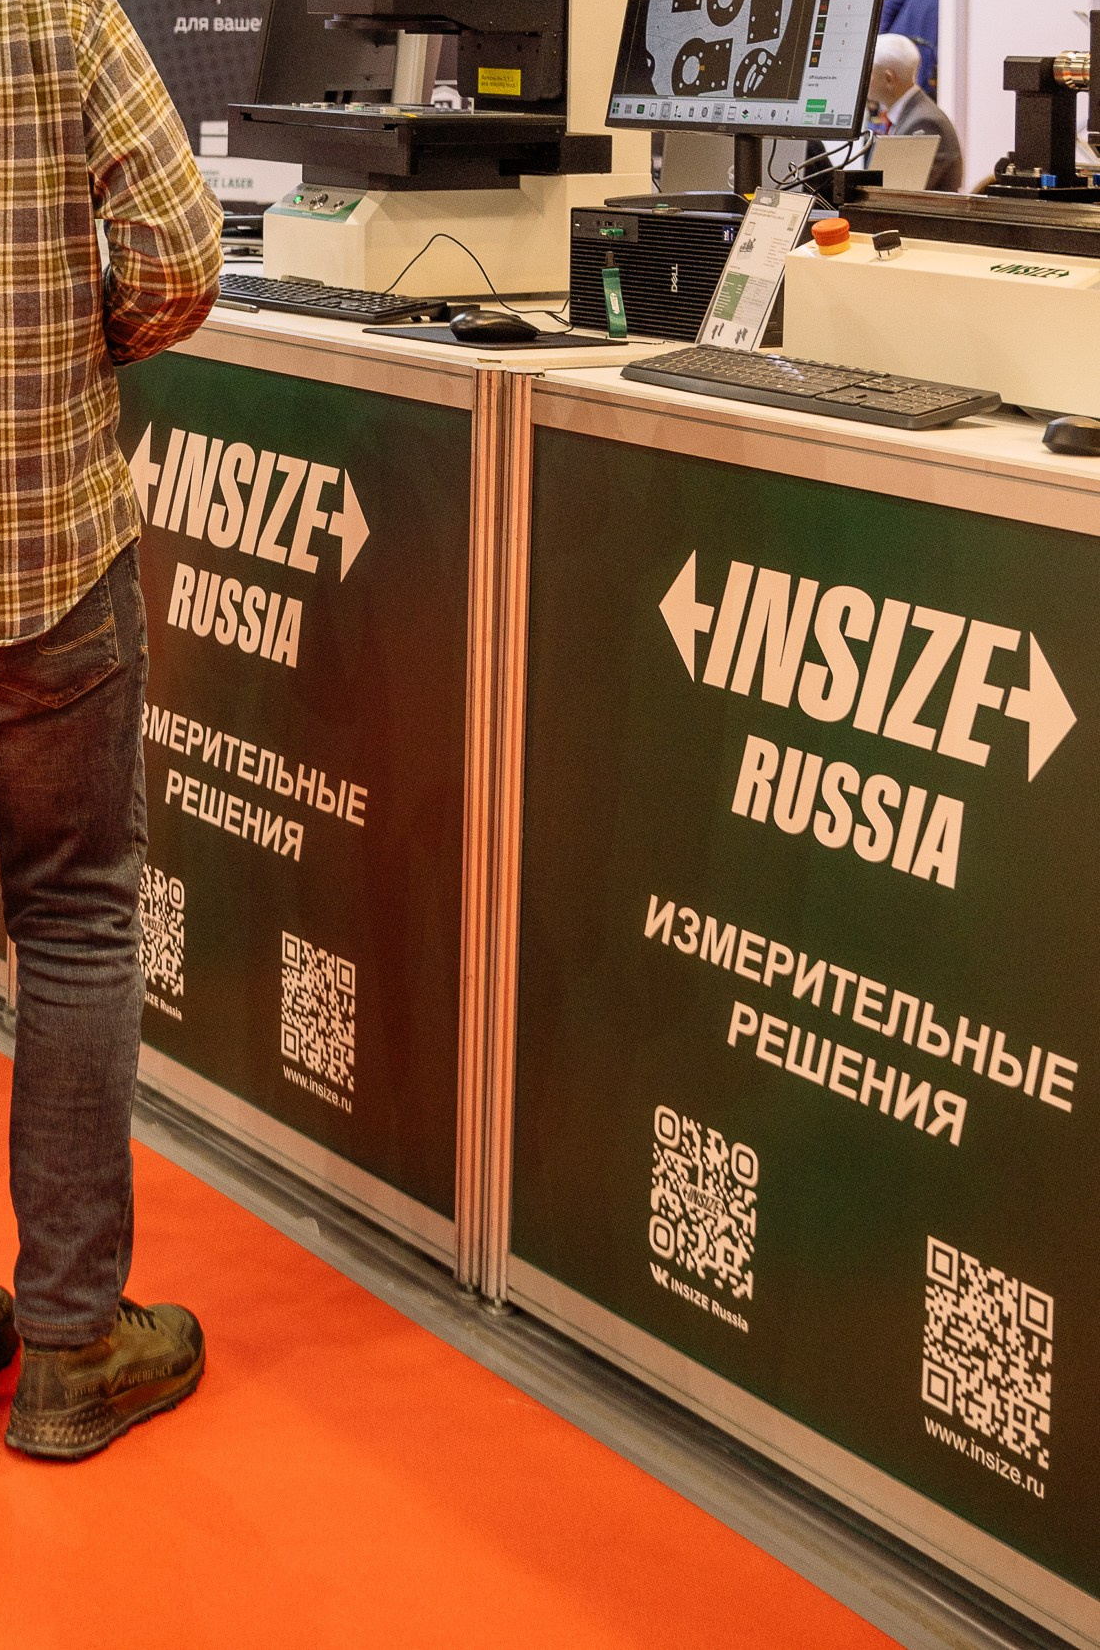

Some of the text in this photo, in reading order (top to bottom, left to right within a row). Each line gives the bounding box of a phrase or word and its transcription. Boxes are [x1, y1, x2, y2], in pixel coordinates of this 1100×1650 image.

[173, 16, 263, 34] для ваше
[222, 178, 253, 189] LASER
[995, 264, 1060, 278] INSIZE
[152, 427, 340, 574] INSIZE
[167, 562, 302, 668] RUSSIA
[702, 560, 1022, 767] INSIZE
[165, 769, 303, 863] РЕШЕНИЯ
[731, 734, 964, 889] RUSSIA
[160, 999, 182, 1022] Russia
[644, 894, 1079, 1112] ИЗМЕРИТЕЛЬНЫЕ
[283, 1064, 352, 1114] www.insize.ru
[727, 1001, 968, 1147] РЕШЕНИЯ
[687, 1188, 721, 1212] INSIZE
[670, 1277, 709, 1311] INSIZE
[711, 1299, 749, 1334] Russia
[924, 1416, 1045, 1500] www.insize.ru
